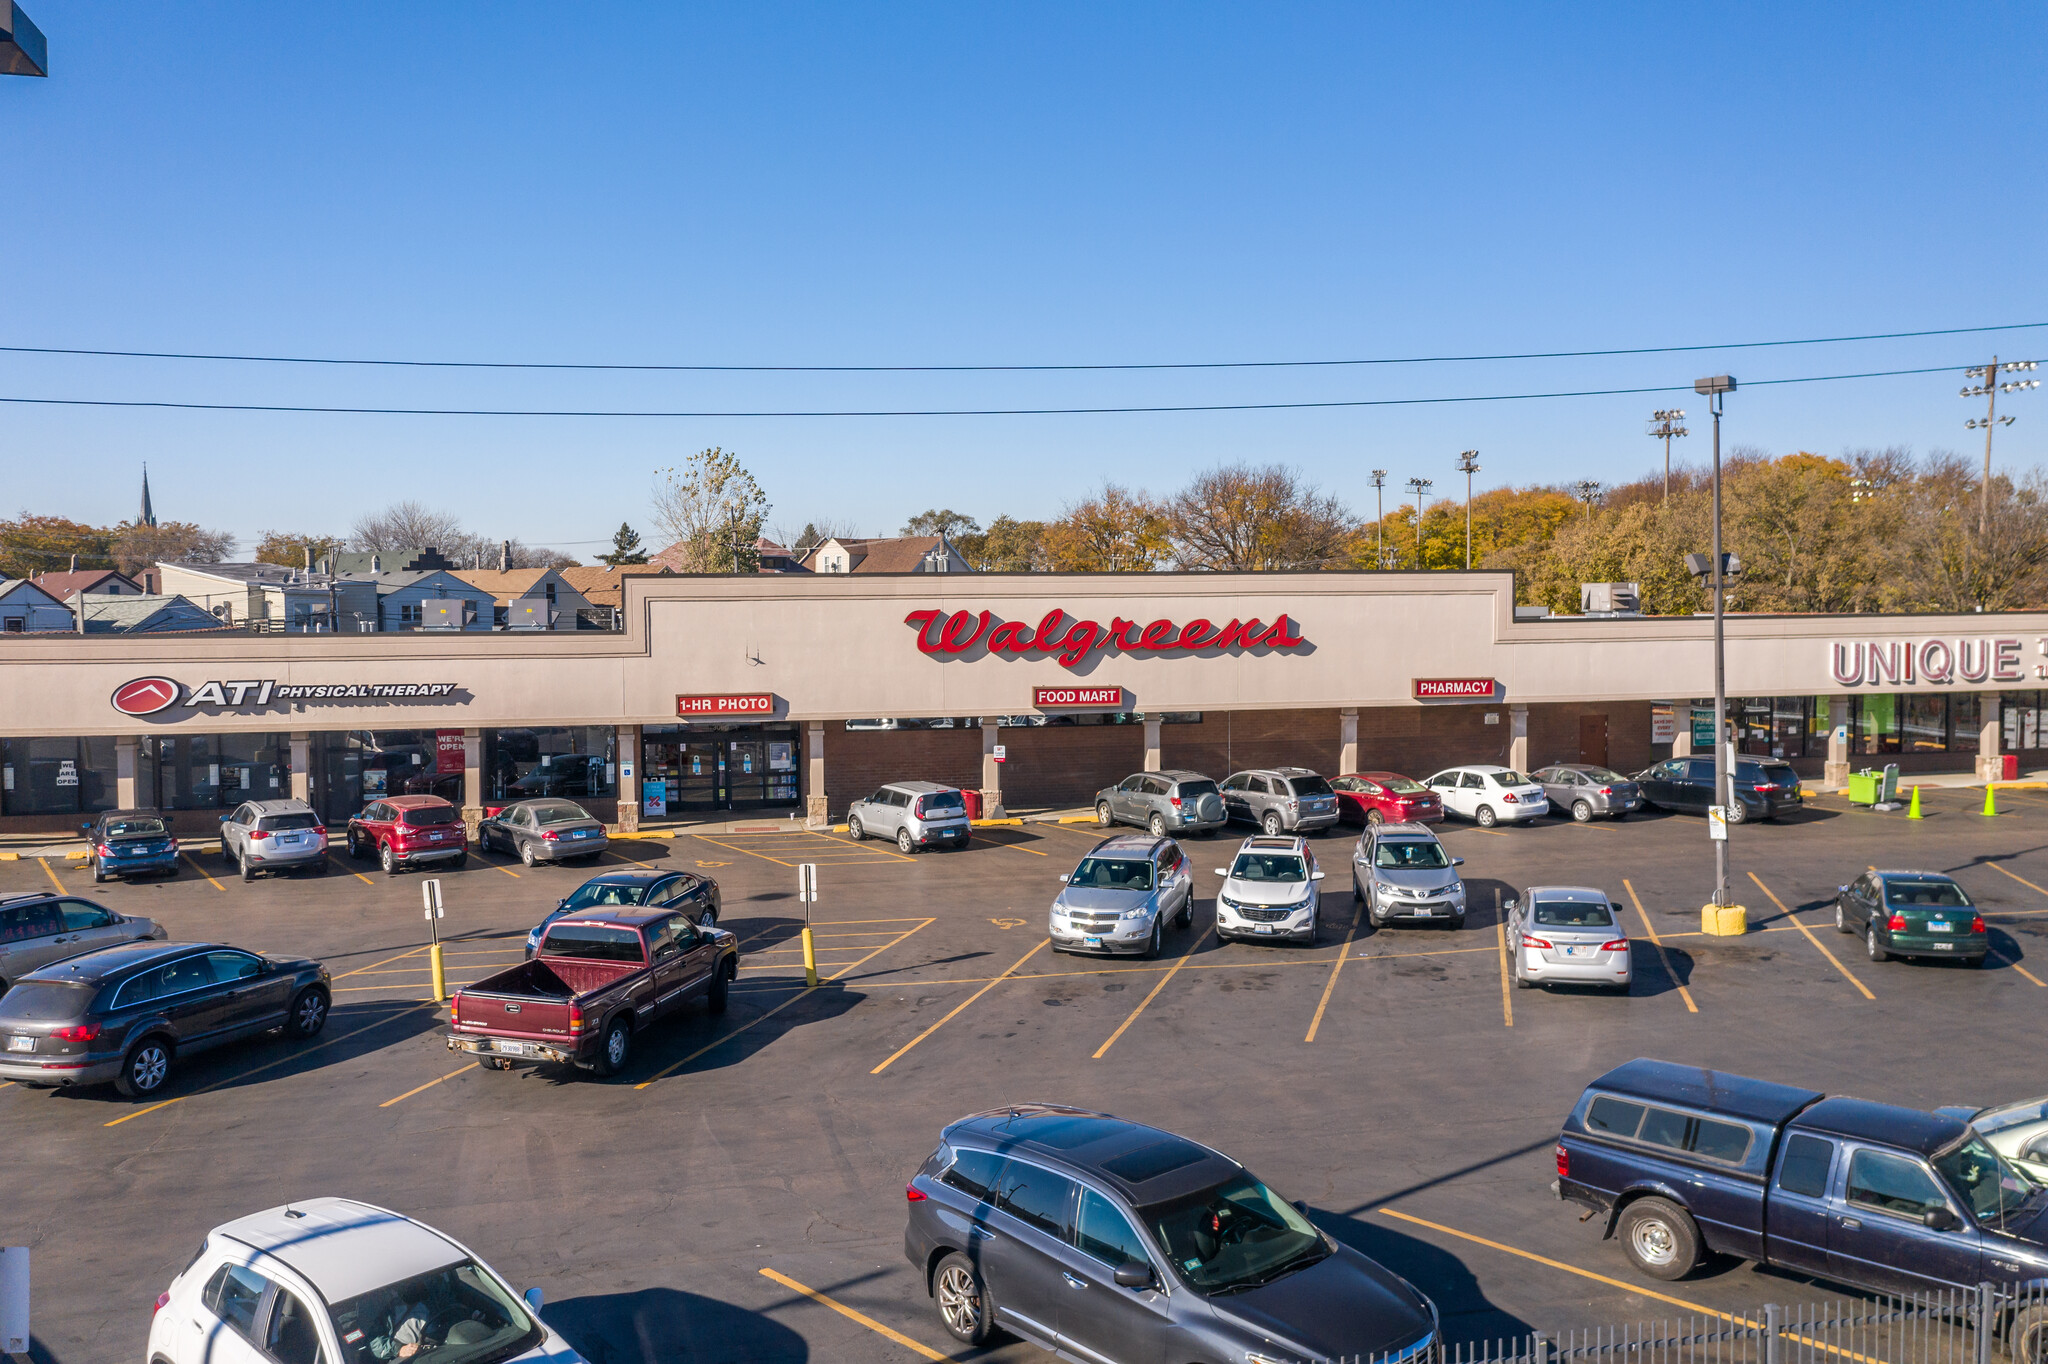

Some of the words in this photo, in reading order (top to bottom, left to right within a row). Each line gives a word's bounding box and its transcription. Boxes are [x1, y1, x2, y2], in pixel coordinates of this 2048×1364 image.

[904, 608, 1305, 667] Walgreens
[1830, 639, 2018, 684] UNIQUE
[183, 680, 276, 706] ATI
[277, 685, 368, 698] PHYSICAL
[372, 683, 456, 696] THERAPY
[1038, 691, 1076, 703] FOOD
[1079, 690, 1117, 702] MART
[1420, 681, 1489, 694] PHARMACY
[680, 699, 712, 711] 1-HR
[718, 697, 769, 710] PHOTO
